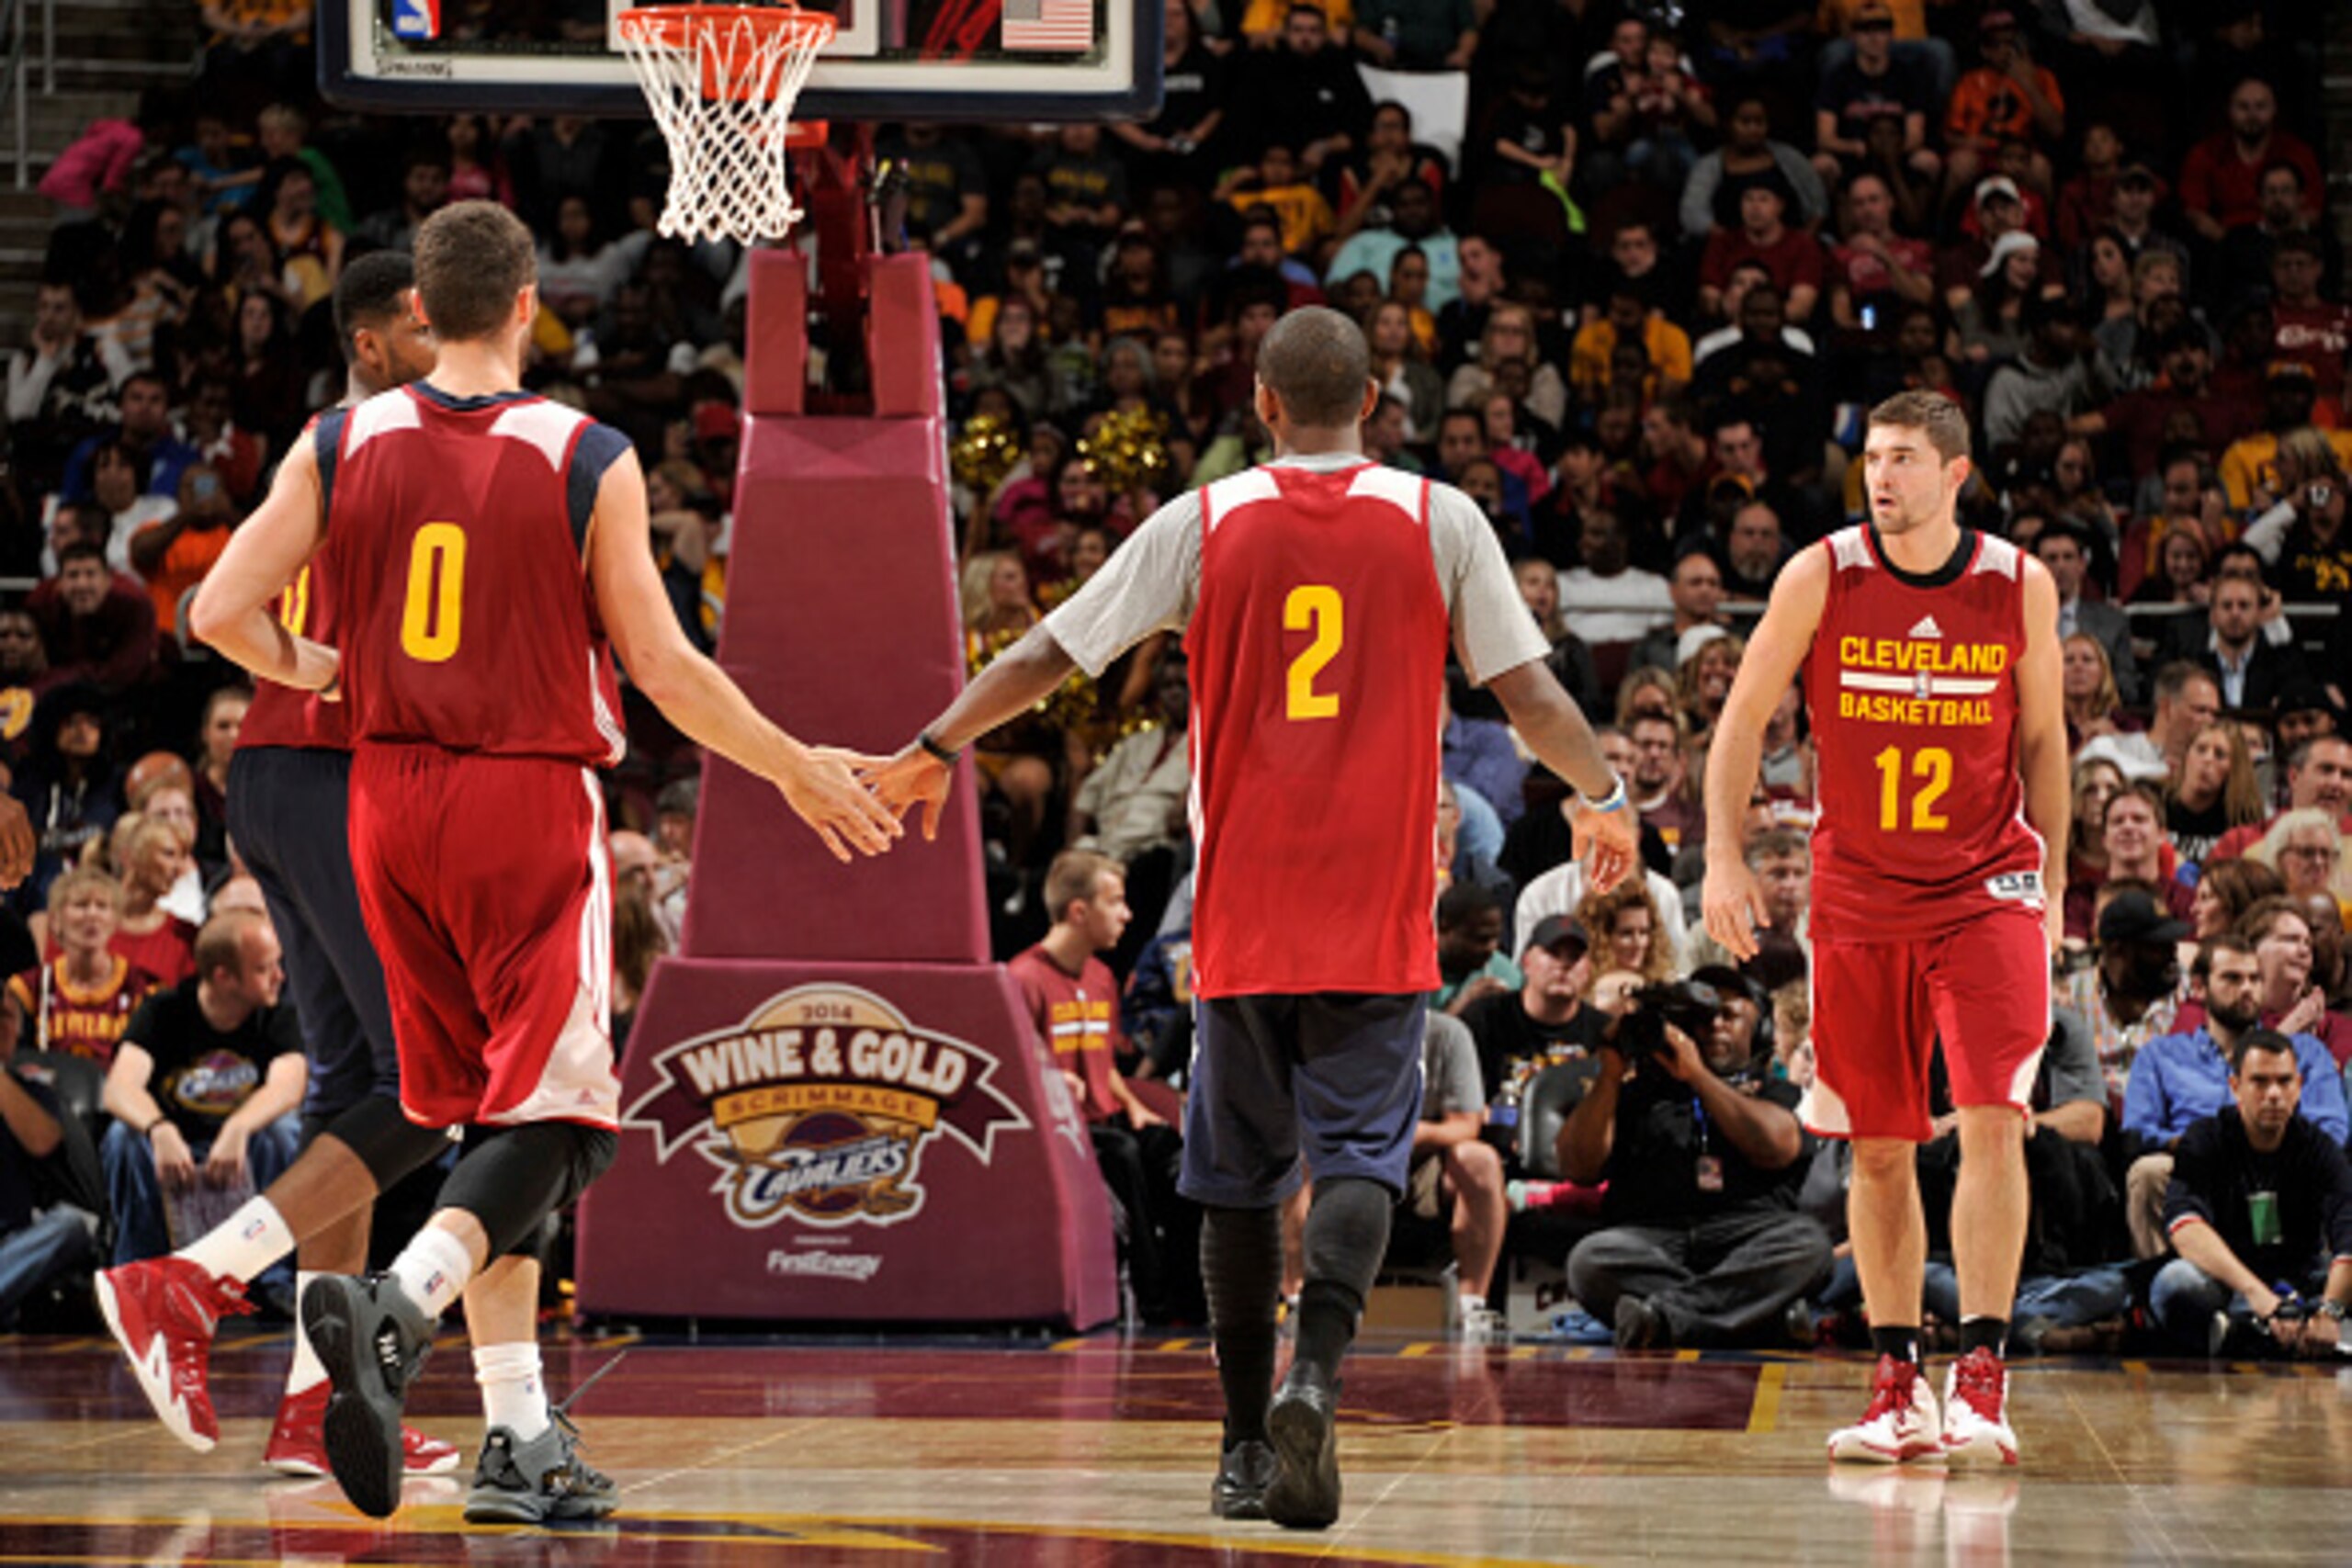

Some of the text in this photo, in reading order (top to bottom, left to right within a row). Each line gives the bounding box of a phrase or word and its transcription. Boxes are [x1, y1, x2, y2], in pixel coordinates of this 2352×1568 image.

[401, 522, 466, 662] 0
[1283, 584, 1343, 721] 2
[1840, 635, 2007, 674] CLEVELAND
[1839, 691, 1994, 726] BASKETBALL
[1874, 744, 1953, 830] 12
[799, 1004, 854, 1021] 2014
[682, 1027, 967, 1095] WINE & GOLD
[726, 1086, 921, 1118] SCRIMMAGE
[766, 1250, 880, 1280] FirstEnergy
